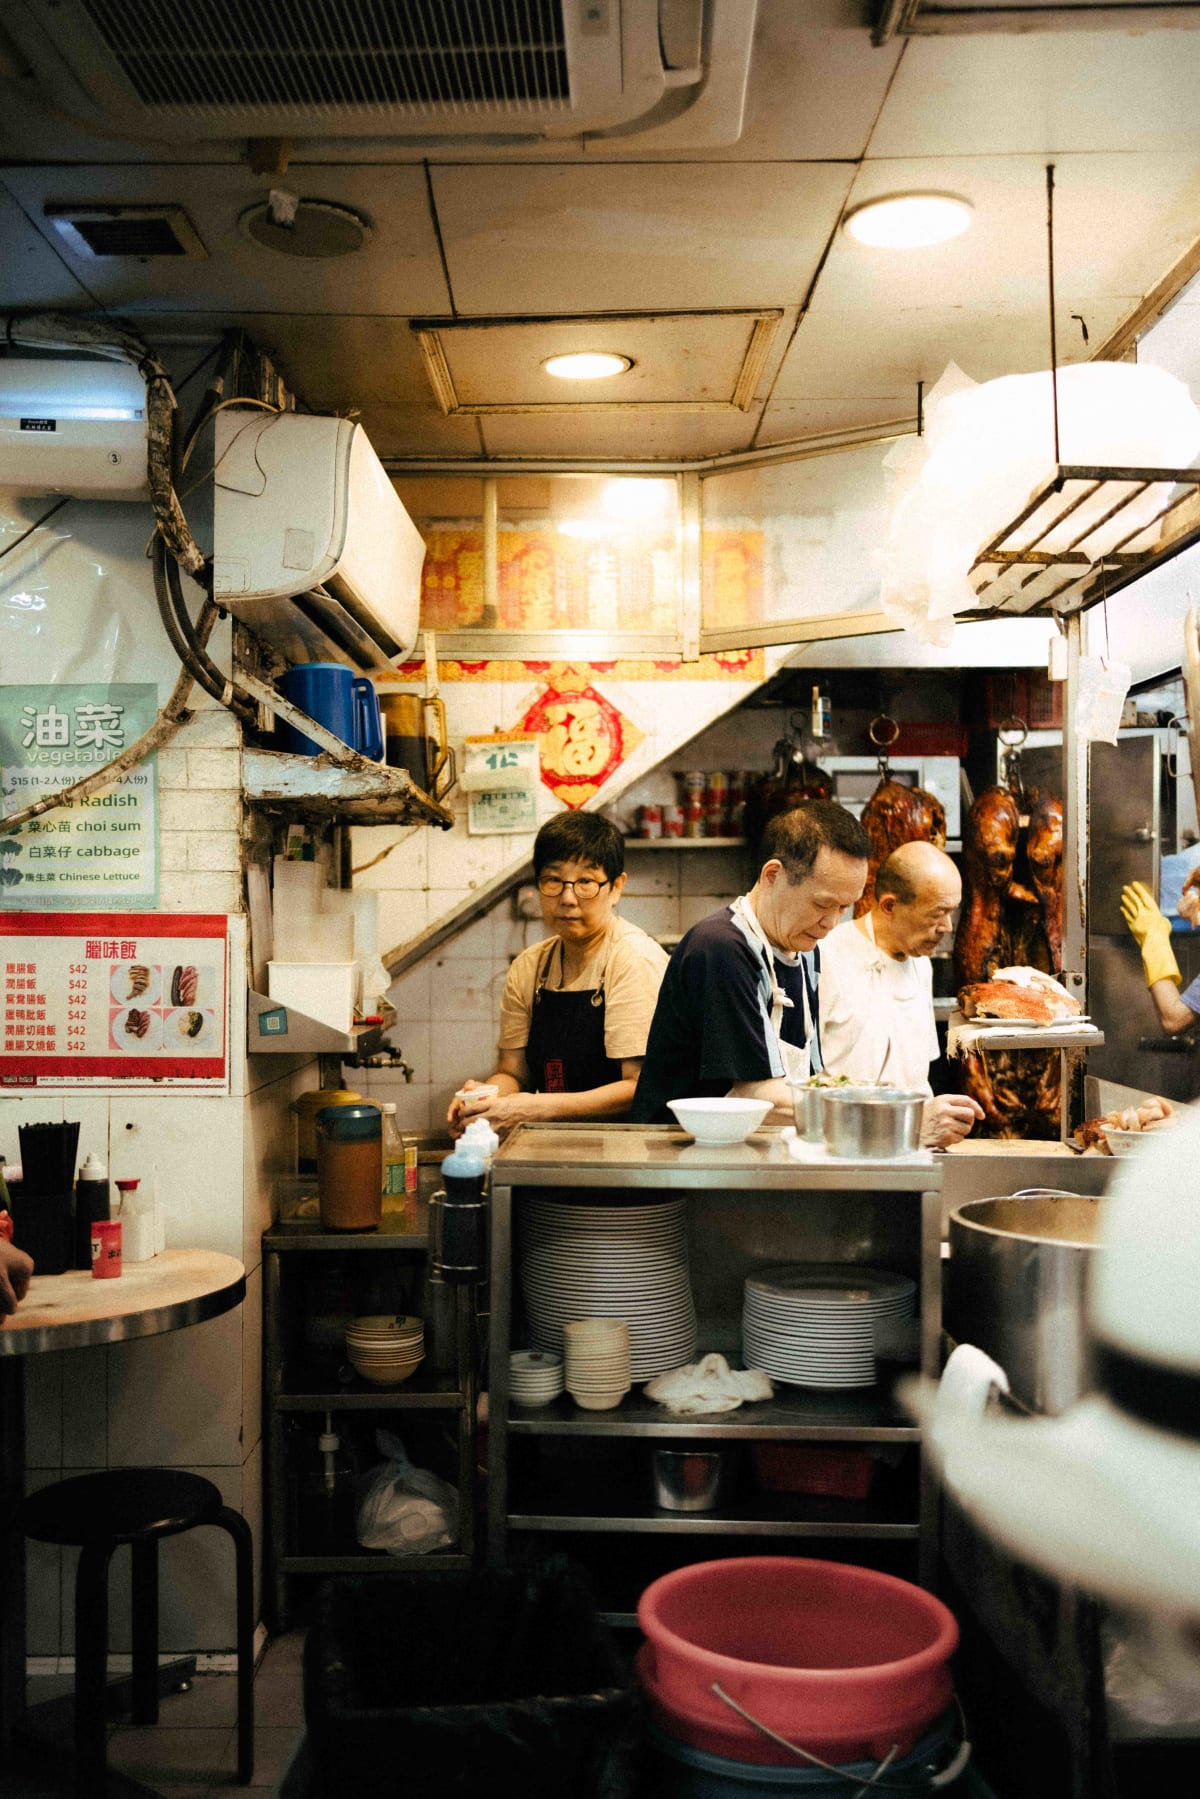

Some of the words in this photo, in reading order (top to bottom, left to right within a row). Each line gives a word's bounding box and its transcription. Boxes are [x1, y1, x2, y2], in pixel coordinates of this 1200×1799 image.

[111, 453, 118, 463] 3
[20, 703, 123, 748] 油菜
[10, 776, 28, 786] $15
[80, 793, 138, 807] Radish
[27, 821, 71, 833] 菜心苗
[76, 820, 107, 832] choi
[111, 822, 141, 832] sum
[29, 846, 72, 858] 白菜仔
[76, 845, 140, 858] cabbage
[59, 872, 101, 881] Chinese
[103, 872, 140, 880] Lettuce
[85, 940, 137, 960] 臘味飯
[69, 964, 88, 974] $42
[69, 979, 88, 989] $42
[68, 995, 87, 1005] $42
[67, 1010, 87, 1020] $42
[67, 1026, 86, 1036] $42
[67, 1041, 86, 1051] $42
